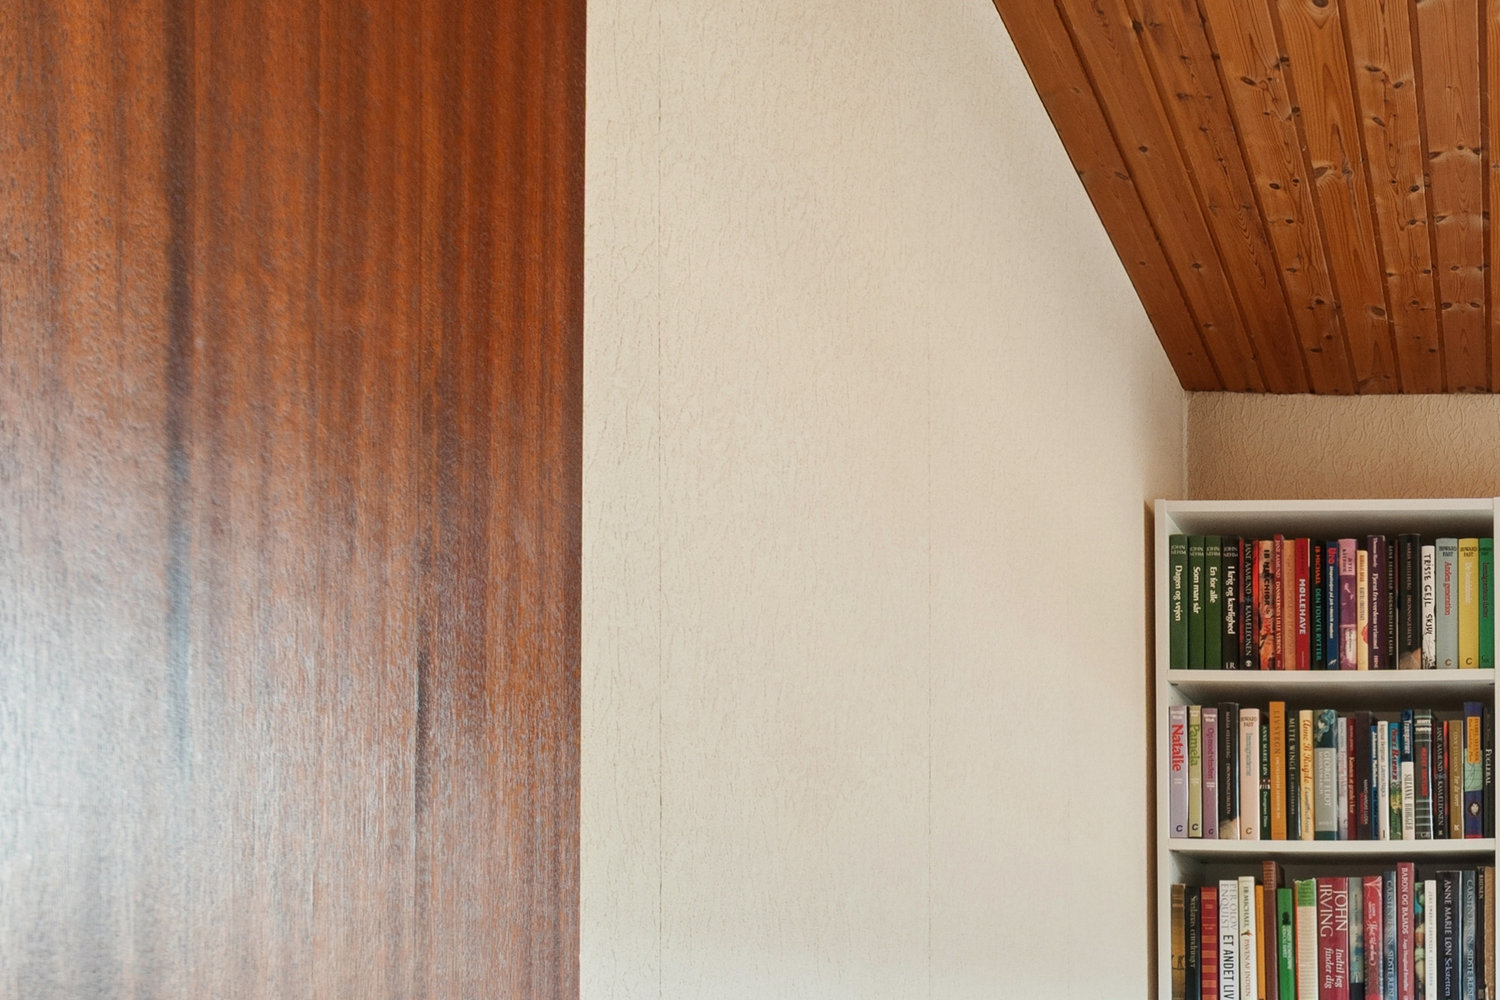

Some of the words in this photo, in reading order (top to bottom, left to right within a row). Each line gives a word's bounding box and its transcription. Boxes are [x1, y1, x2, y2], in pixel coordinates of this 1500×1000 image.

[1174, 565, 1183, 589] Dagen
[1210, 567, 1217, 576] En
[1226, 571, 1235, 585] krig
[1424, 554, 1433, 581] TRISSE
[1174, 591, 1182, 600] og
[1226, 587, 1233, 596] og
[1424, 585, 1432, 607] GEJL
[1174, 602, 1182, 621] vejen
[1193, 603, 1201, 613] sår
[1226, 598, 1235, 634] kærlighed
[1425, 614, 1433, 635] SKJUL
[1172, 724, 1183, 772] Natalie
[1190, 724, 1199, 766] Pamela
[1444, 880, 1452, 904] ANNE
[1320, 884, 1333, 937] IRVING
[1334, 890, 1347, 931] JOHN
[1444, 907, 1452, 934] MARIE
[1223, 935, 1233, 945] ET
[1444, 937, 1452, 955] LØN
[1223, 950, 1234, 980] ANDET
[1325, 948, 1333, 973] finder
[1336, 949, 1344, 973] Indtil
[1325, 975, 1334, 989] dig
[1335, 976, 1344, 988] jeg
[1444, 958, 1452, 996] Sekstetten
[1224, 985, 1234, 999] LIV
